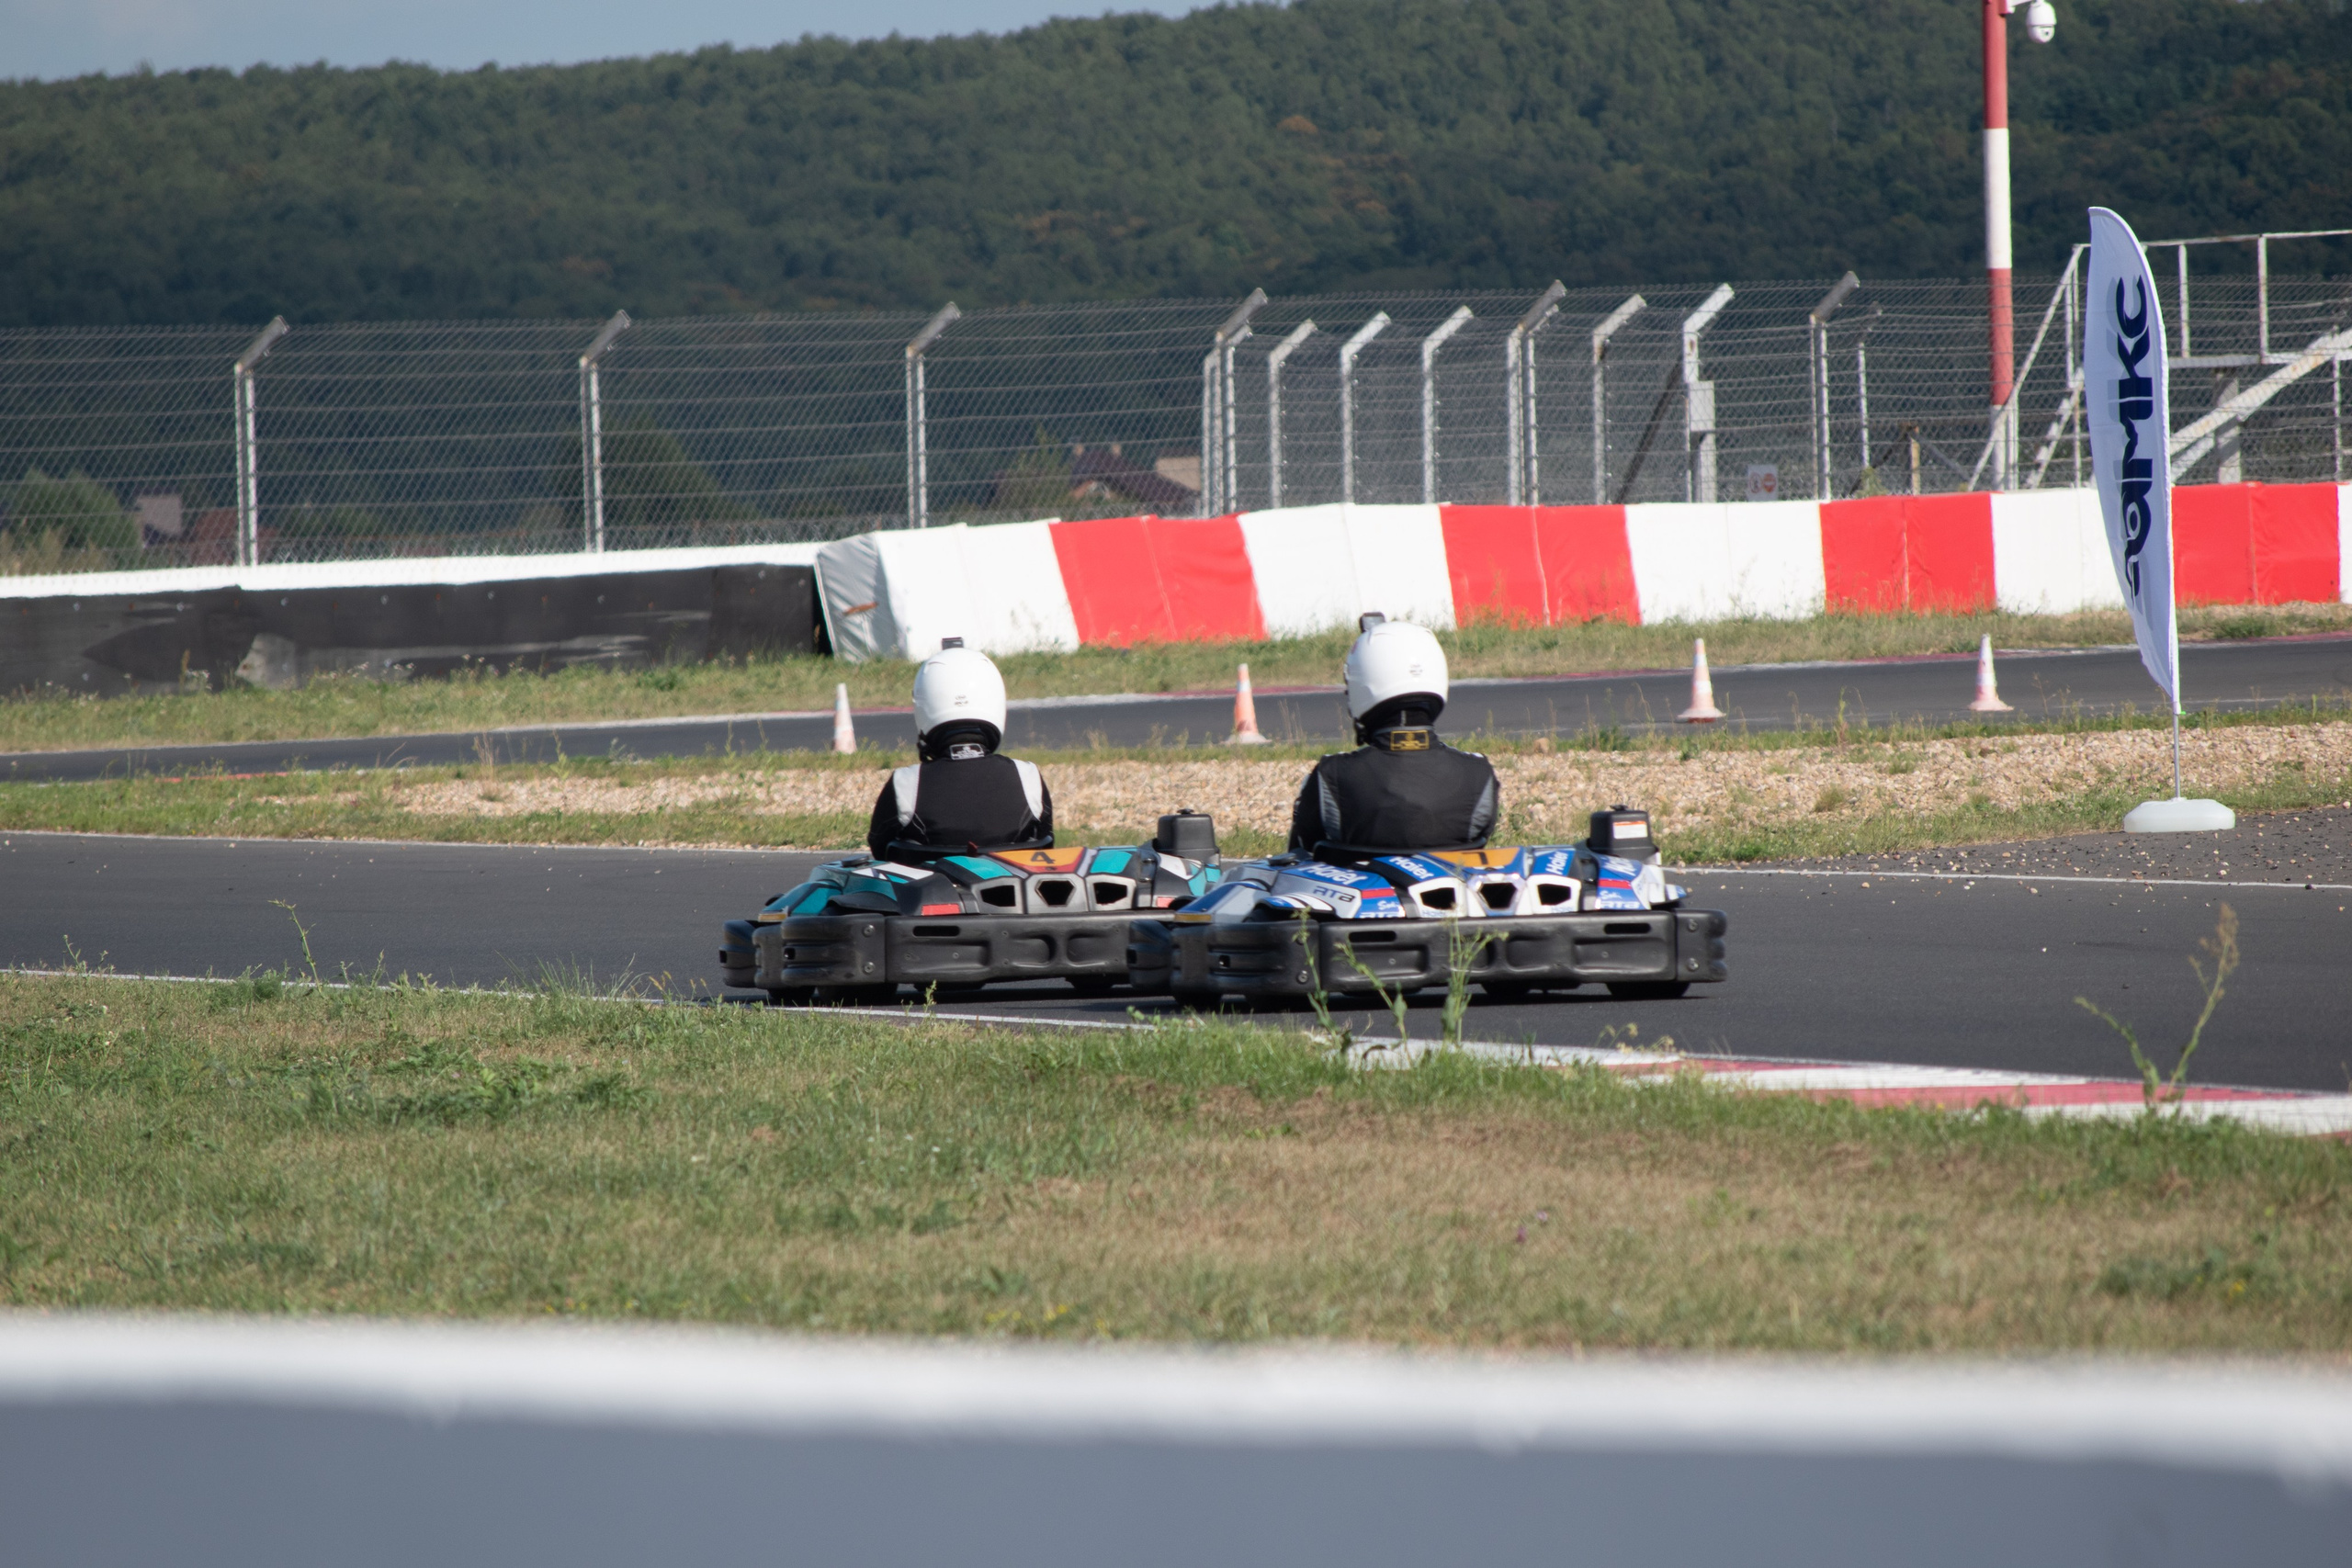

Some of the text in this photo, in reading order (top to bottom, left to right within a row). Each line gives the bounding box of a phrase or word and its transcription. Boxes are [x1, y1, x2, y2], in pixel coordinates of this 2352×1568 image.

[1031, 851, 1056, 864] 4
[1388, 855, 1434, 880] Haier
[1545, 850, 1570, 875] Haier
[1298, 863, 1368, 886] Haier
